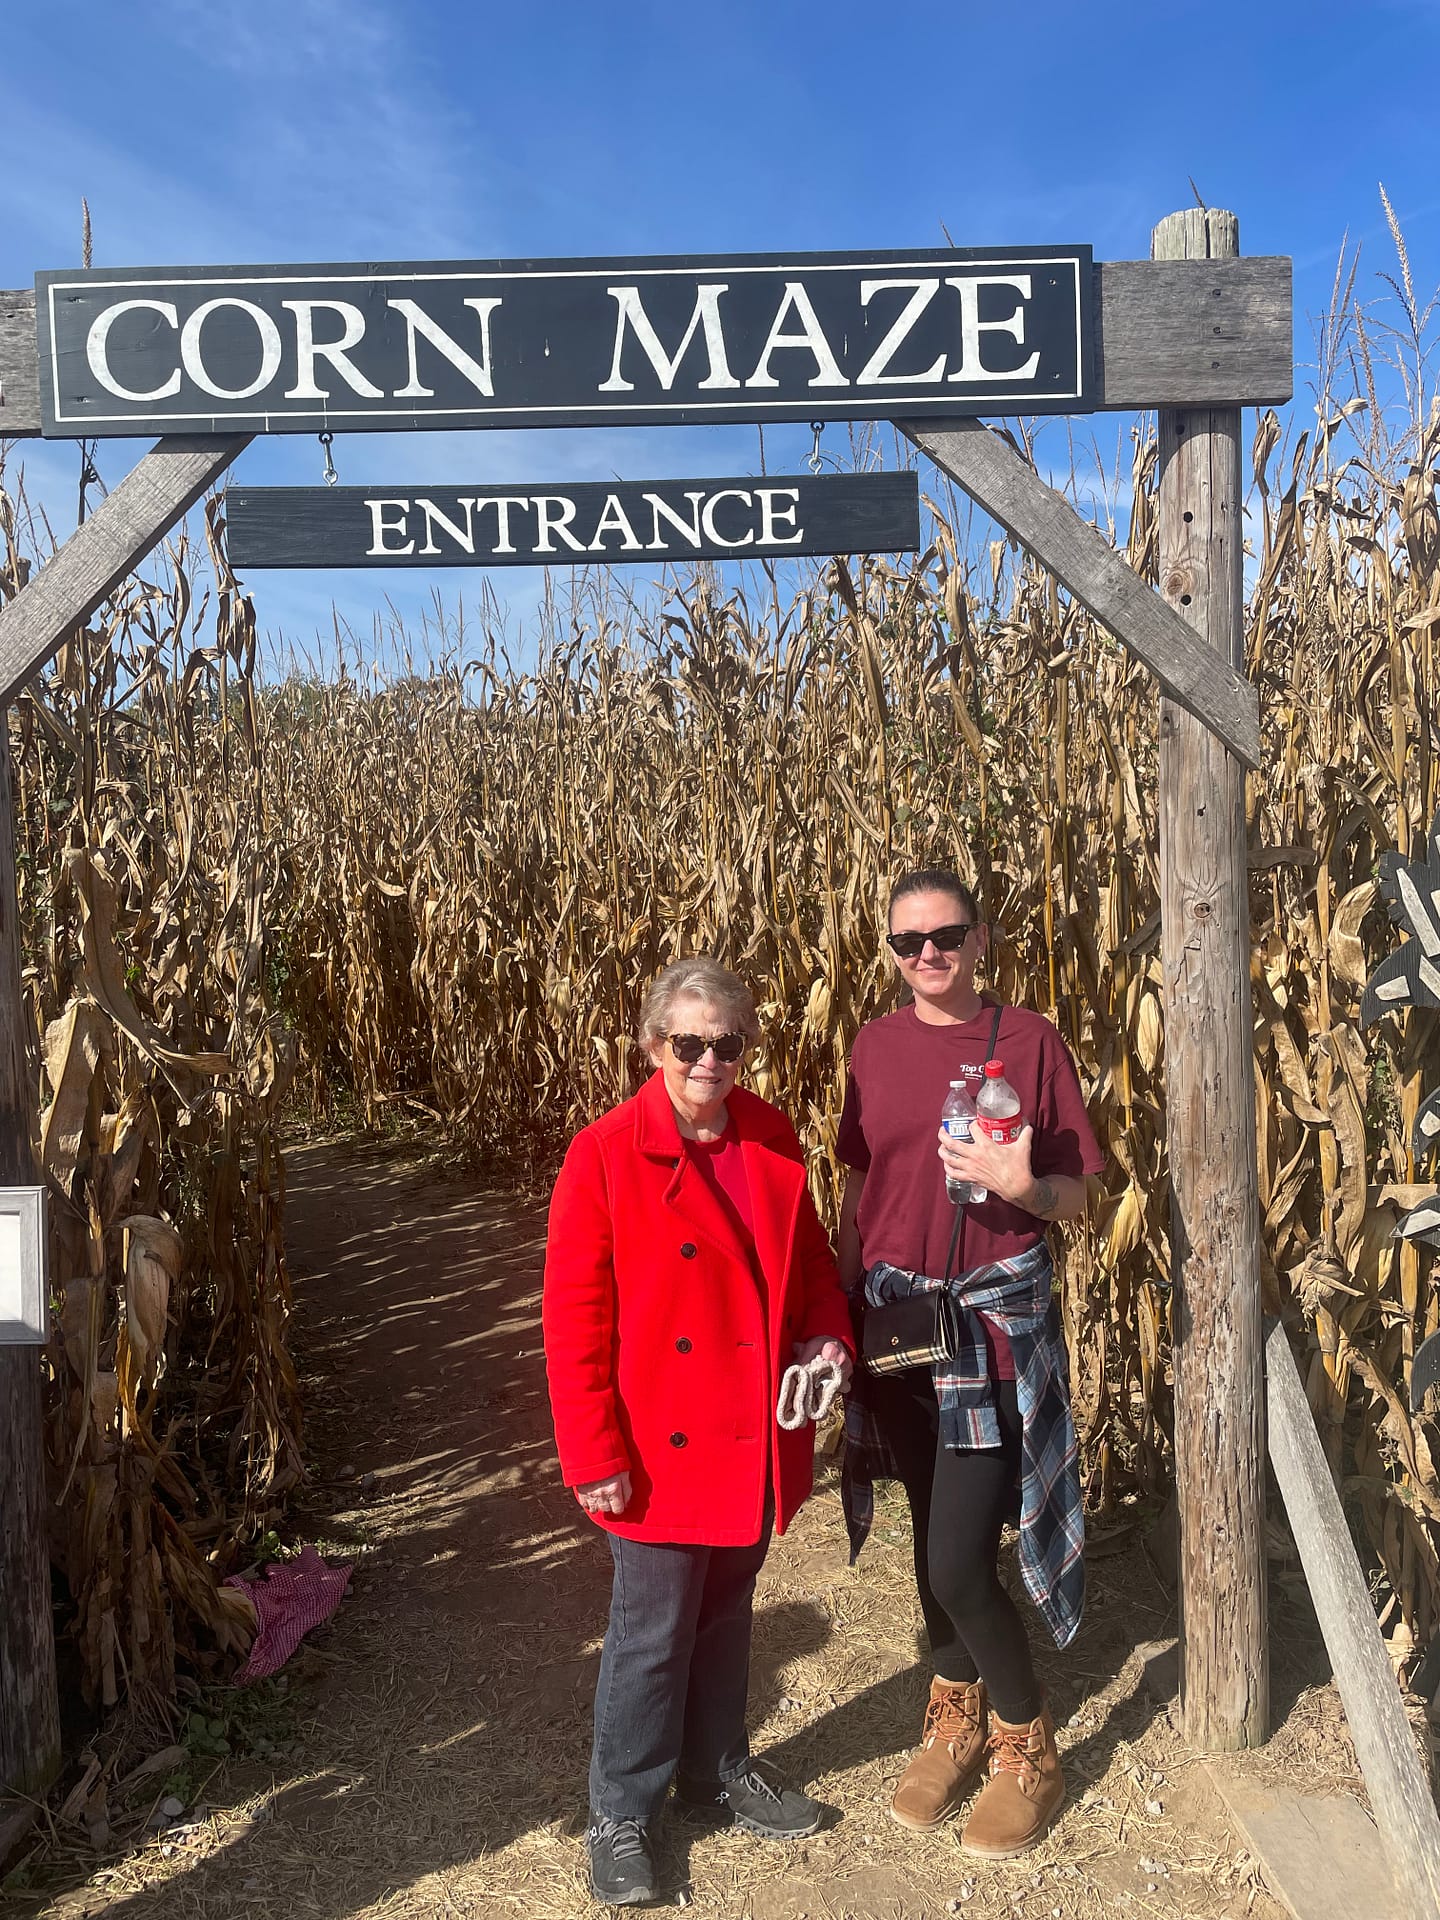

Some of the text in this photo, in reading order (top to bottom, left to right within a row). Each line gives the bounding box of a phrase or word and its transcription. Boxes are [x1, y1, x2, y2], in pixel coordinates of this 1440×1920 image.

[86, 274, 1041, 402] CORN MAZE
[365, 488, 804, 556] ENTRANCE
[959, 1064, 977, 1074] Top
